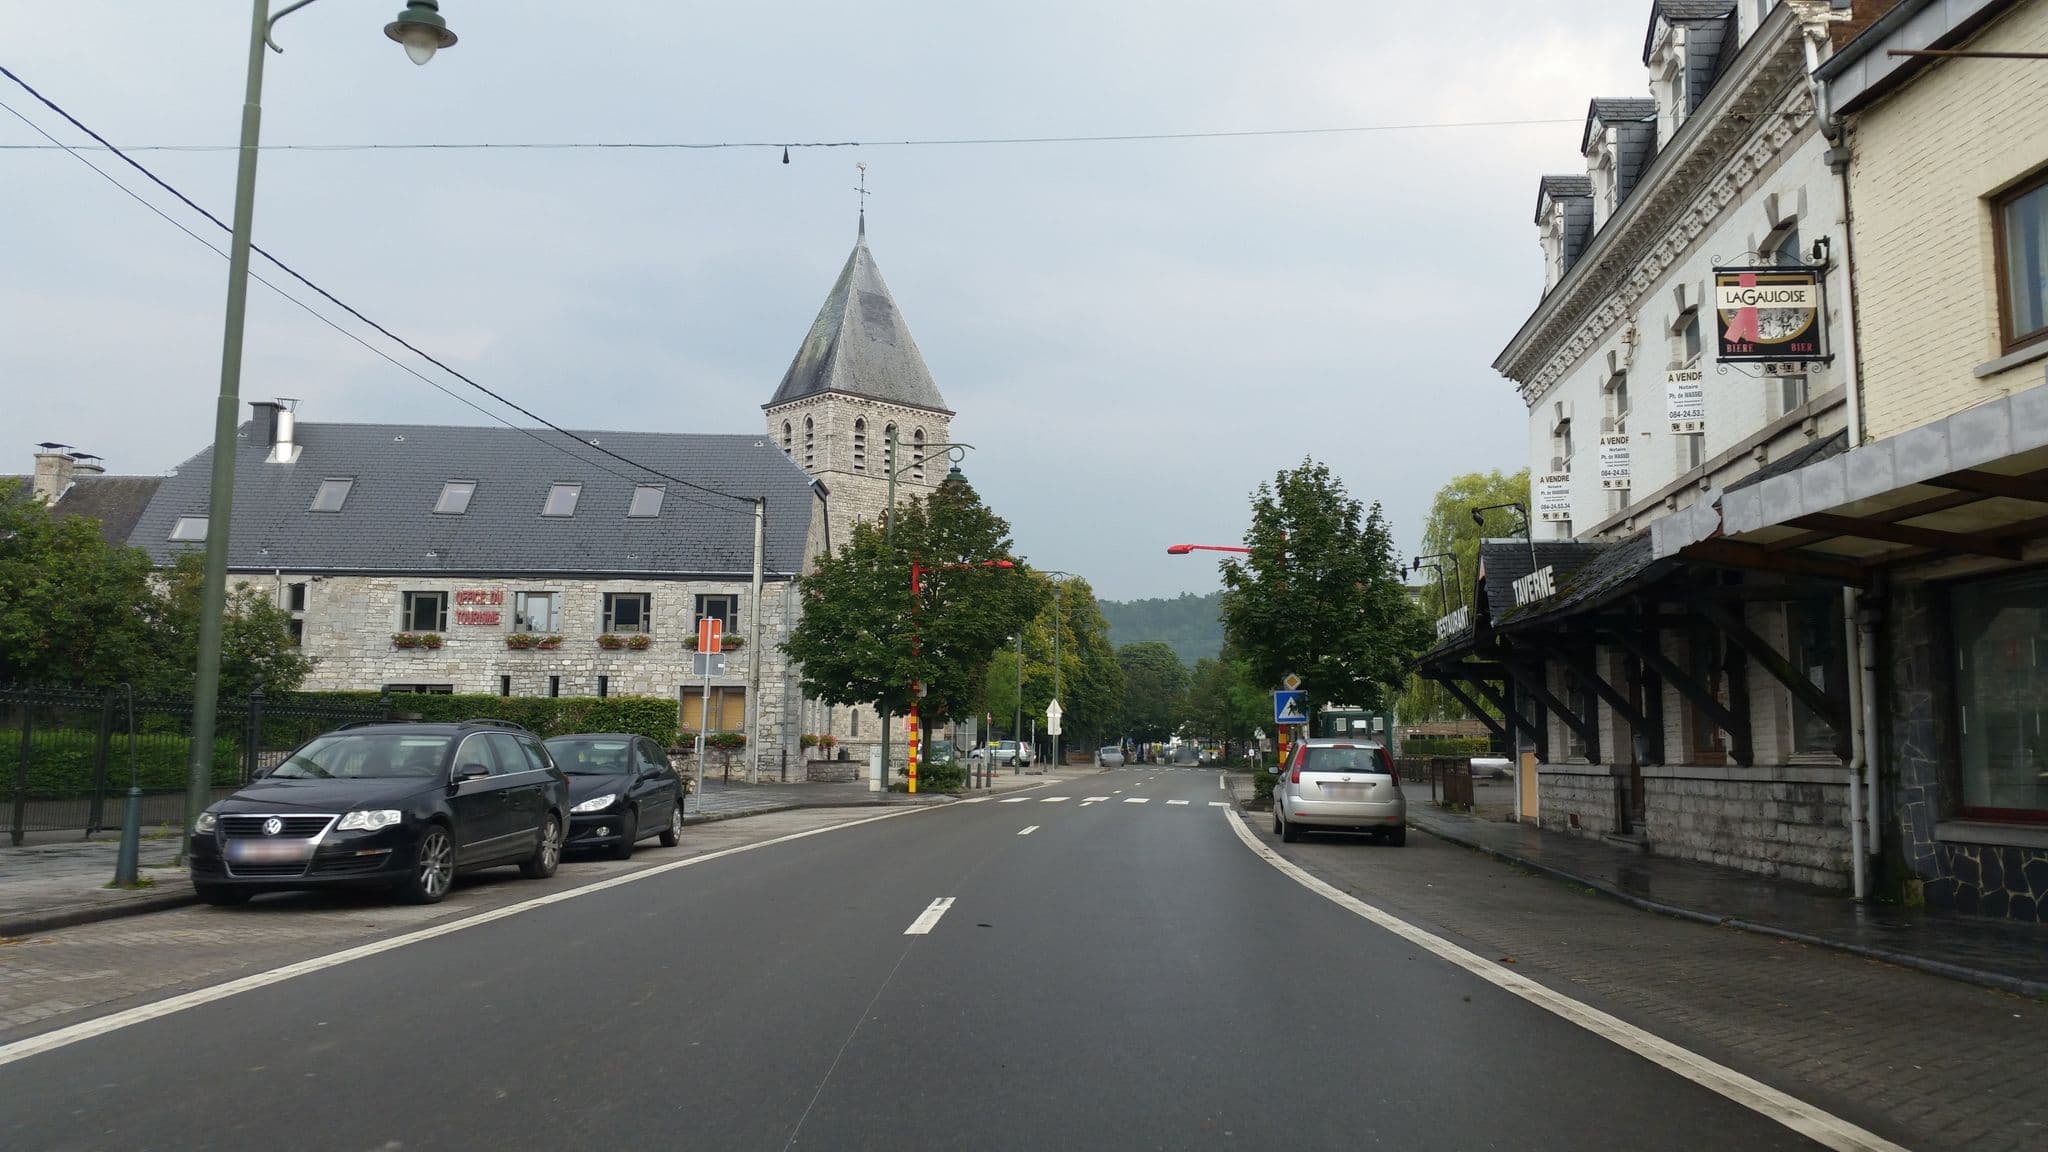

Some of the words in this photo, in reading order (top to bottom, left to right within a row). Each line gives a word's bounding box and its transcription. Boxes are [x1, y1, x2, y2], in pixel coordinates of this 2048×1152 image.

[1791, 342, 1813, 353] BIER
[1668, 374, 1674, 382] A
[1600, 437, 1605, 445] A
[1545, 474, 1570, 483] VENDRE
[1512, 565, 1557, 608] TAVERNE
[456, 590, 486, 605] OFFICE
[490, 590, 503, 605] DU
